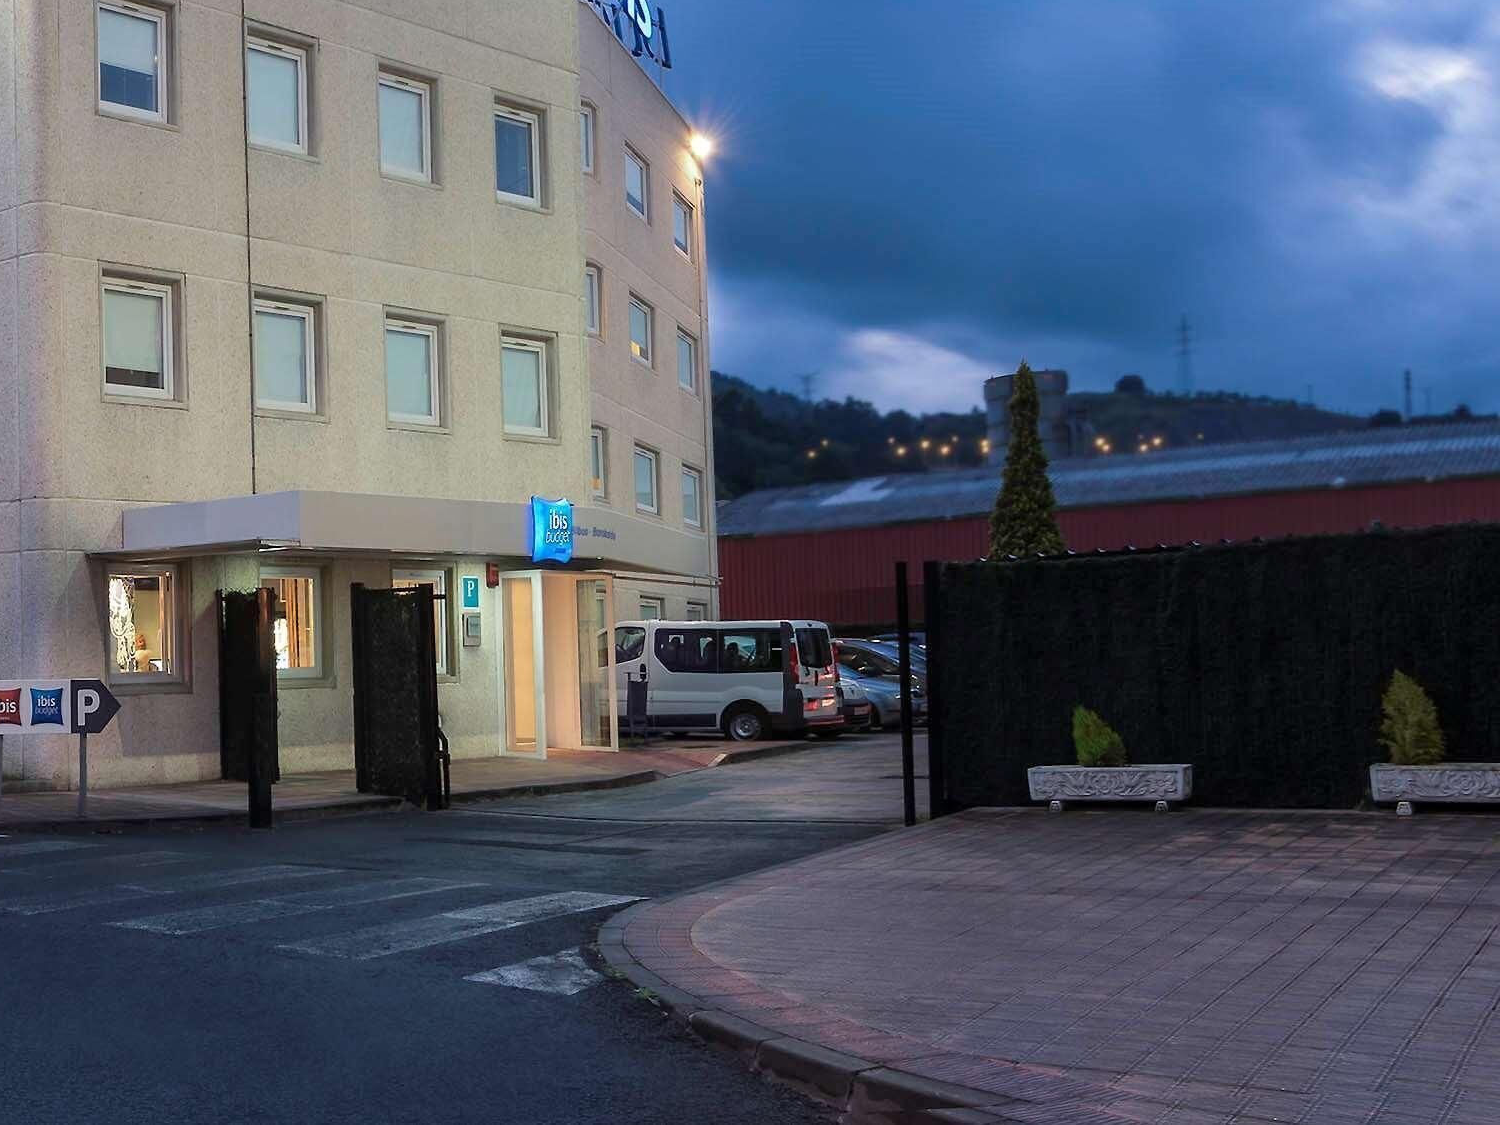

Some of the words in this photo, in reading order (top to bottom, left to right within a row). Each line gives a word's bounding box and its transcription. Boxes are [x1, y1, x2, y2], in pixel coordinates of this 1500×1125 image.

[549, 508, 568, 530] ibis
[545, 529, 571, 546] budget
[467, 580, 475, 597] P
[37, 695, 56, 707] ibis
[77, 688, 101, 727] P
